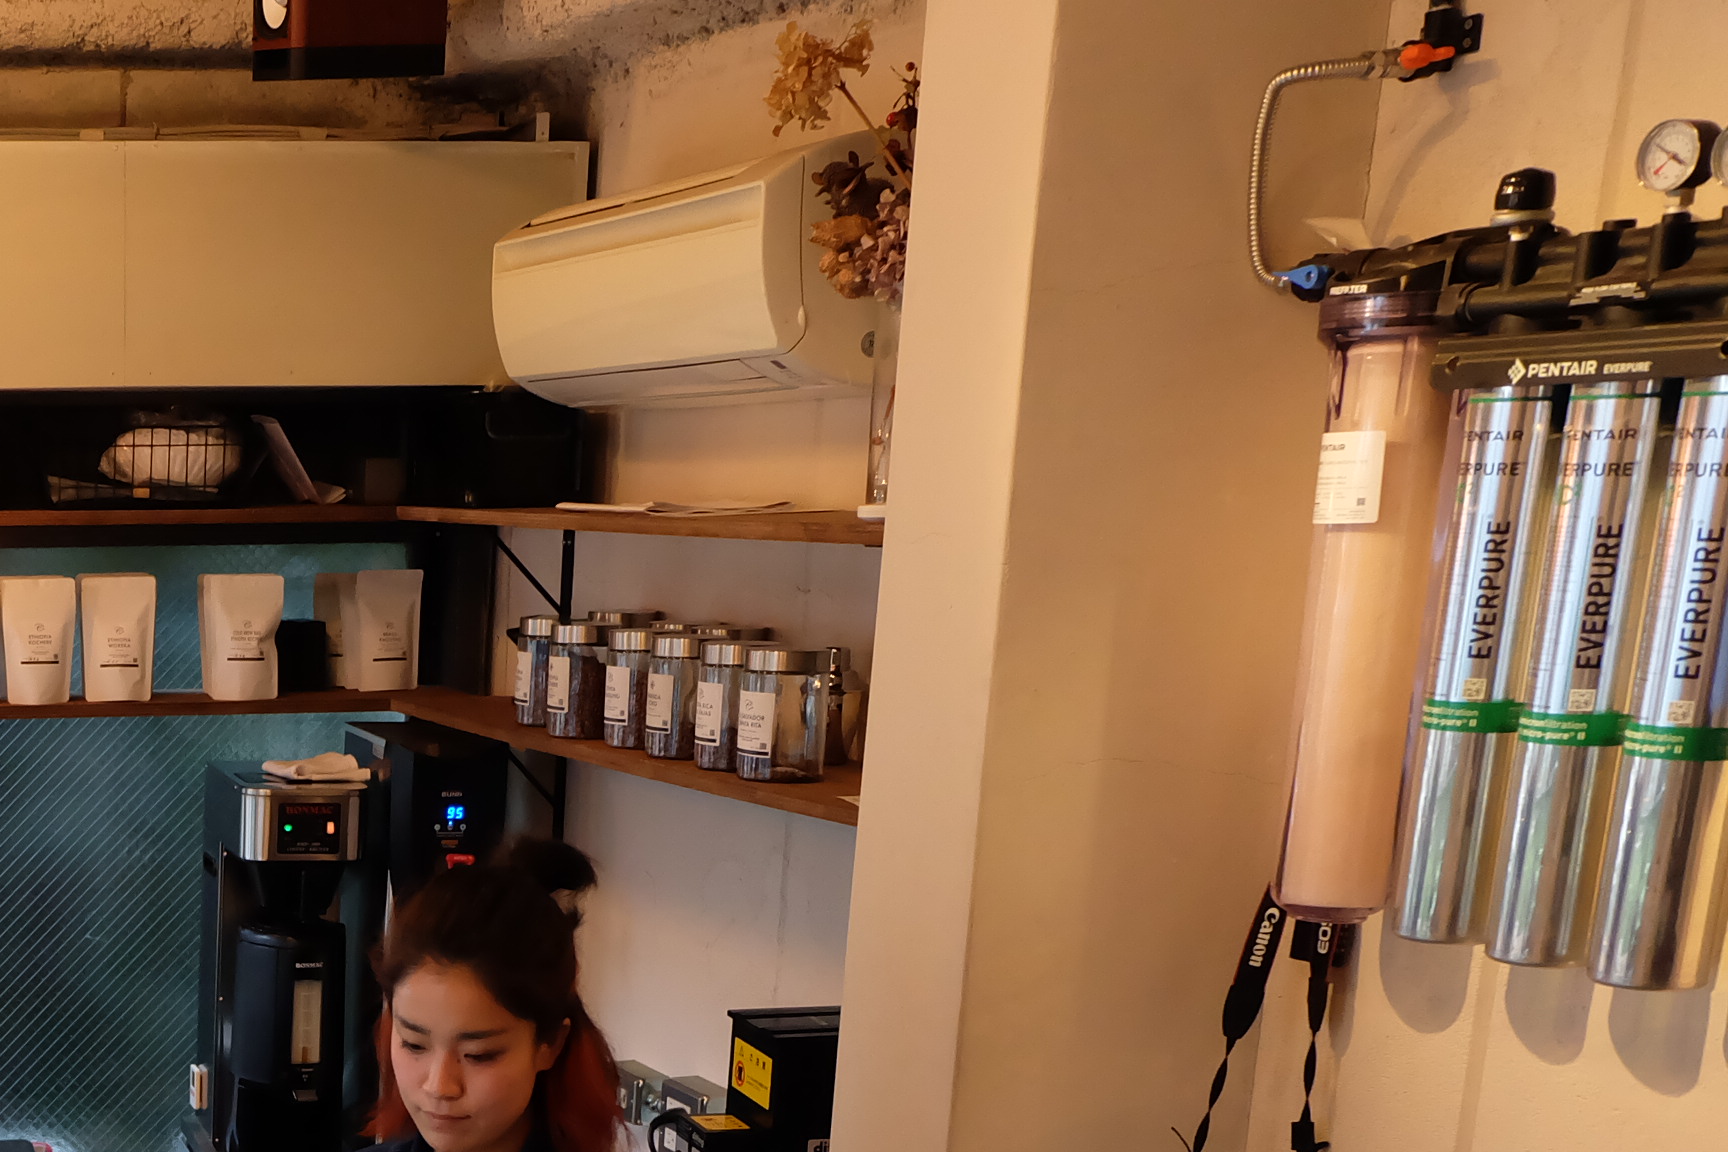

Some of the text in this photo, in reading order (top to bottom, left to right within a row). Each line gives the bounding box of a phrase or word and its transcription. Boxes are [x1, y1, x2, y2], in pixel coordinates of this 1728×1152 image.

[1527, 360, 1651, 378] PENTAIR EVERPURE
[1466, 430, 1524, 442] ENTAIR
[1562, 462, 1635, 477] ERPURE
[1468, 521, 1511, 659] EVERPURE
[1576, 523, 1624, 669] EVERPURE
[1674, 527, 1725, 680] EVERPURE
[285, 805, 334, 815] BONMAC
[447, 806, 465, 820] 95
[1248, 907, 1281, 967] Canon
[1317, 922, 1333, 955] EO
